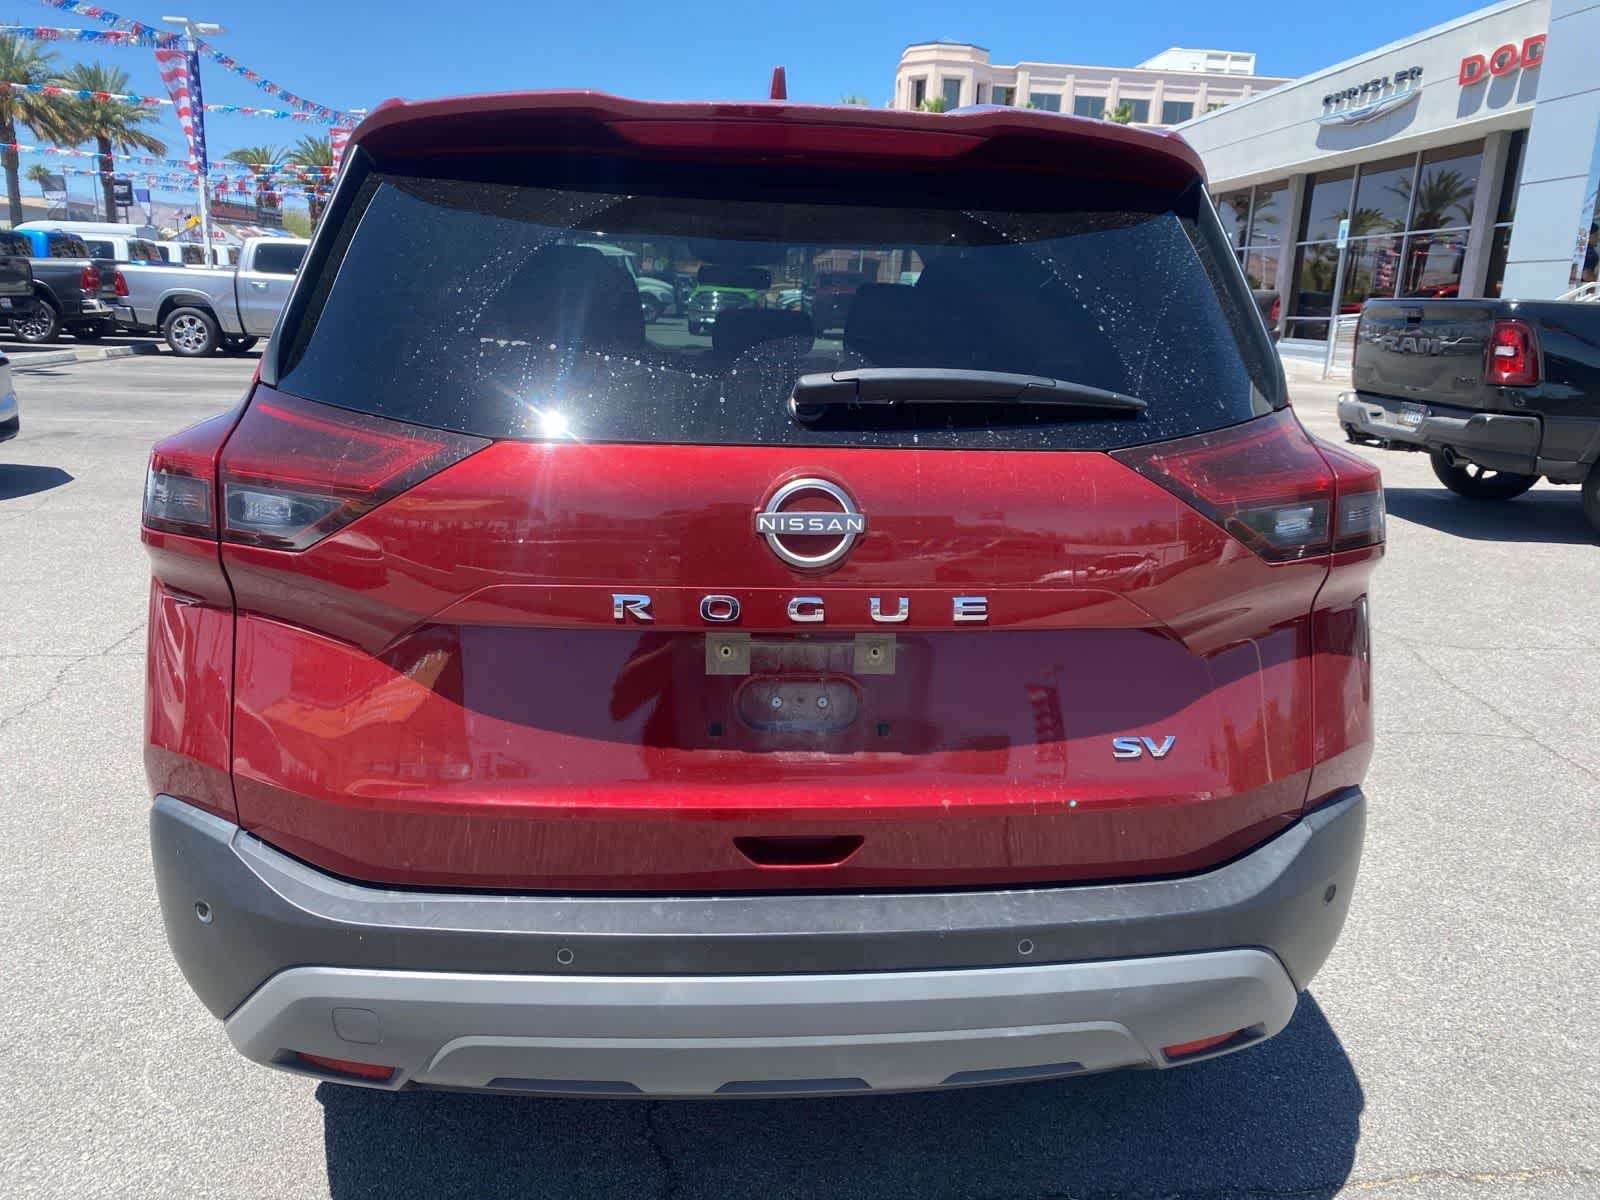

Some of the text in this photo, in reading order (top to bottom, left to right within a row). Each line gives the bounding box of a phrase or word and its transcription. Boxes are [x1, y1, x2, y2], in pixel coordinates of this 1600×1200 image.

[1458, 33, 1547, 86] DOD
[1322, 66, 1423, 107] CHRYSLER
[1379, 336, 1442, 355] RAM
[759, 517, 863, 531] NISSAN
[611, 593, 990, 622] ROGUE
[1112, 735, 1177, 758] SV
